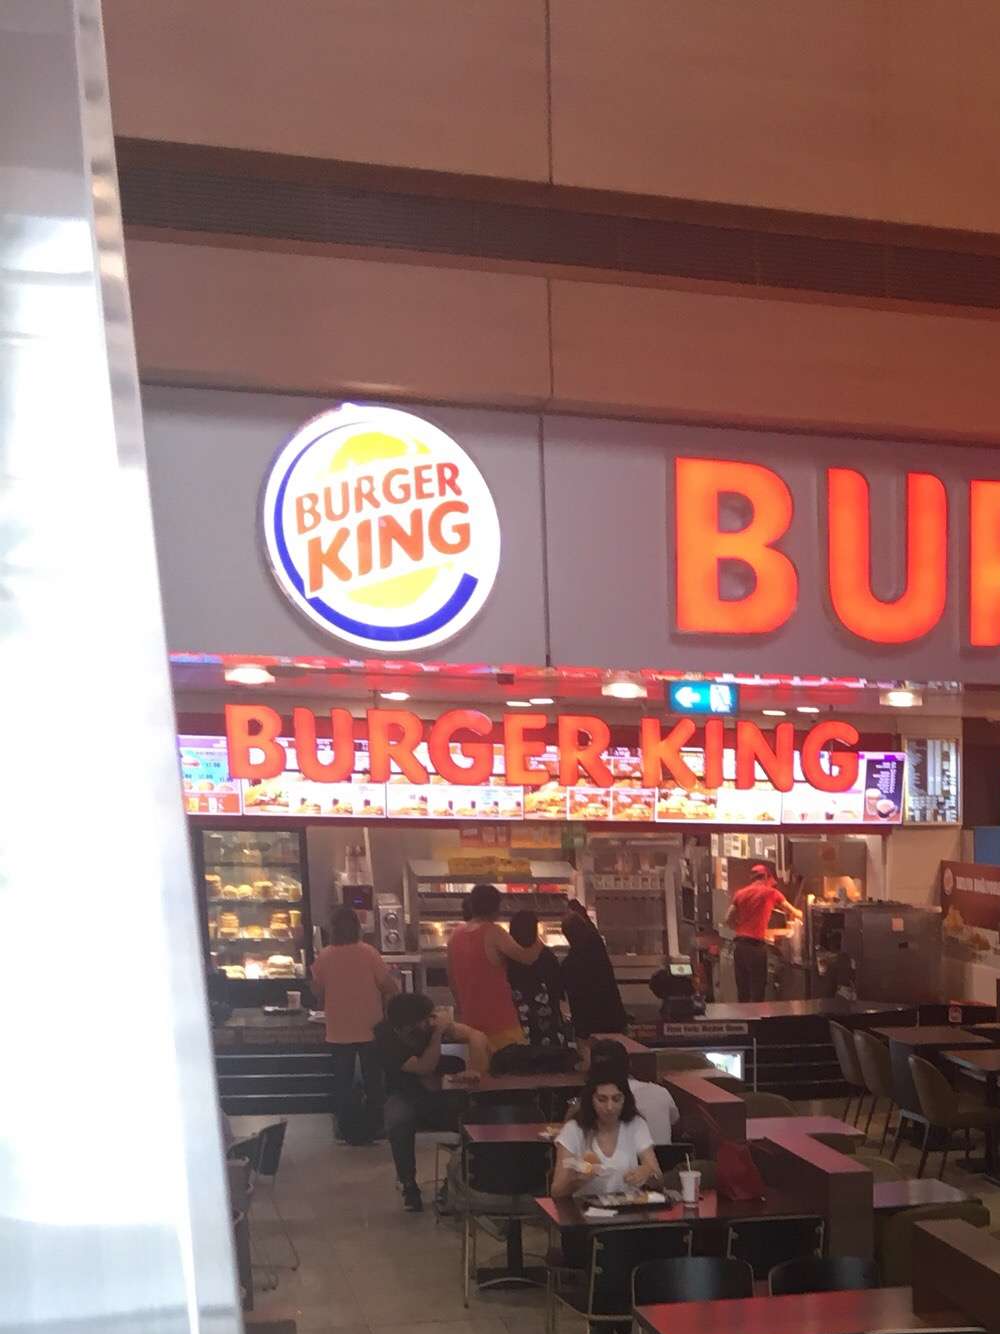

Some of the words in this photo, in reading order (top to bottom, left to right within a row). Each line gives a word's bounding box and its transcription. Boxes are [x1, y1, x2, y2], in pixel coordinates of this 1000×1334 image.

[295, 462, 462, 535] BURGER
[307, 501, 471, 593] KING
[225, 704, 613, 785] BURGER
[641, 717, 860, 793] KING
